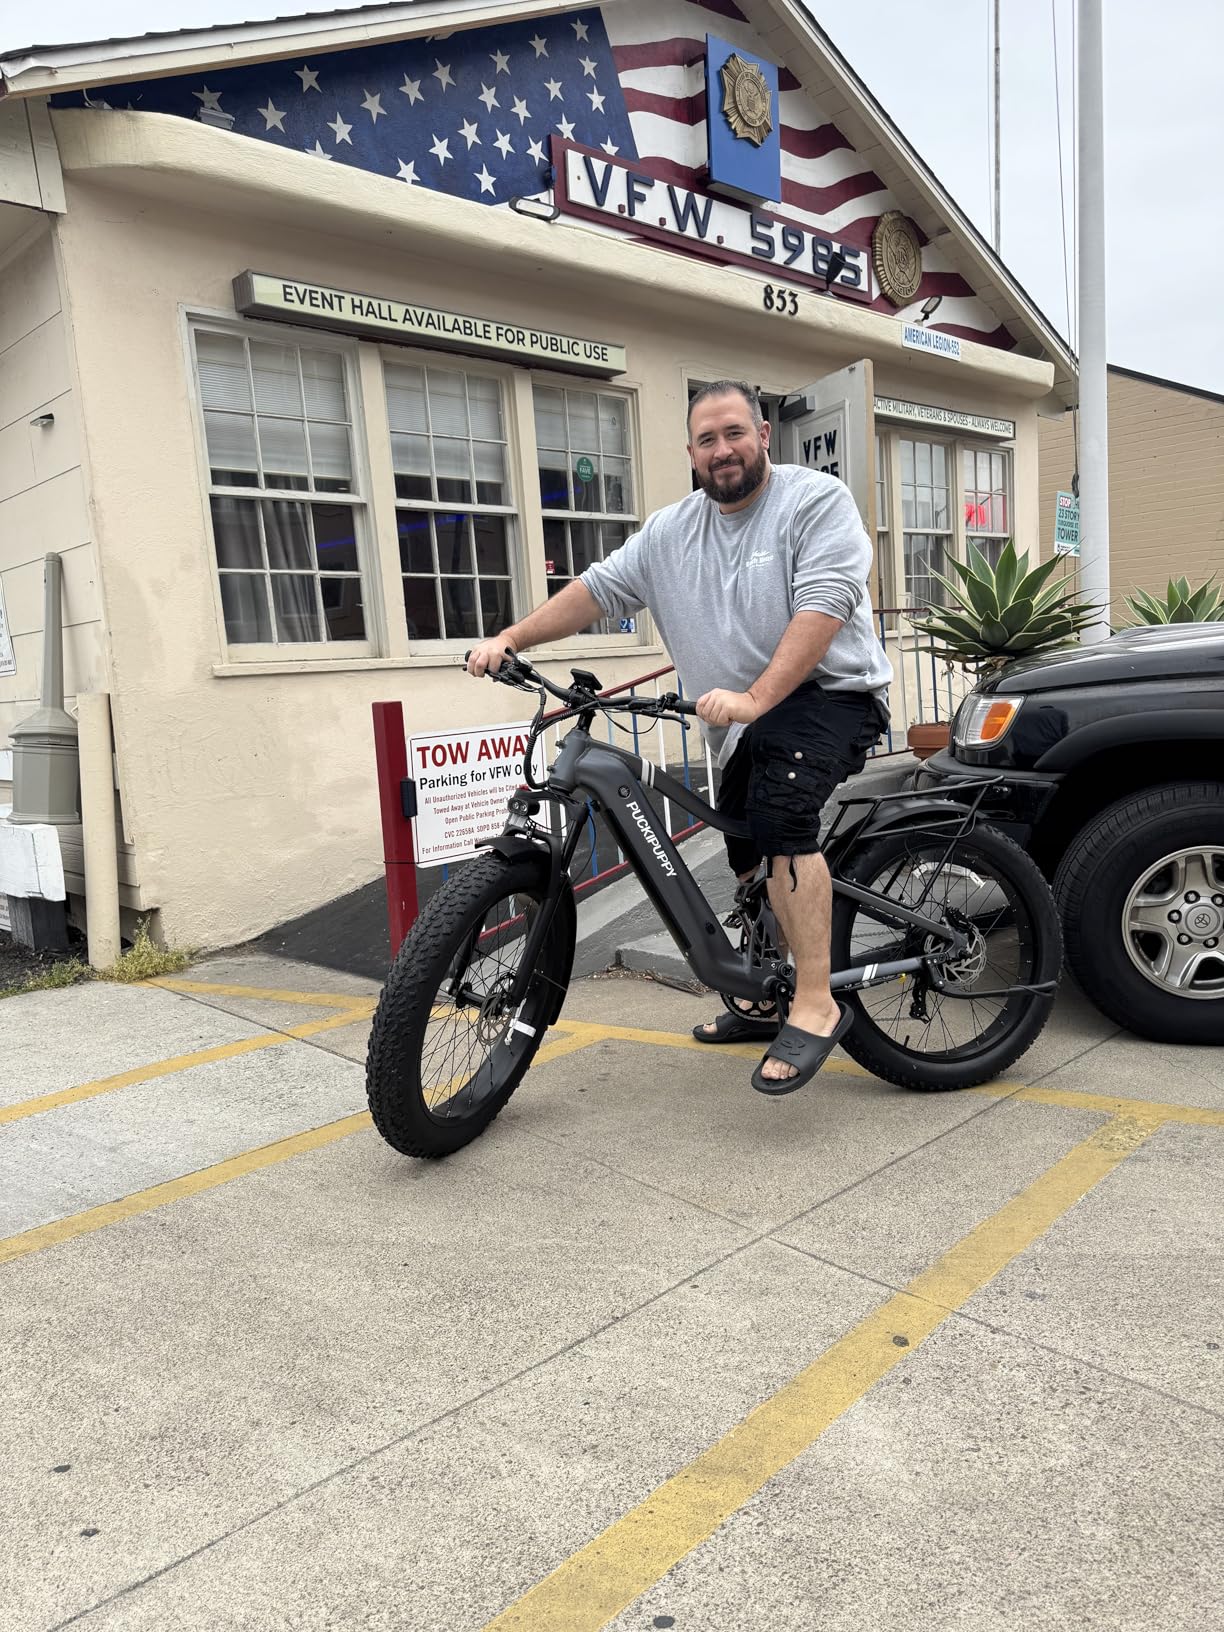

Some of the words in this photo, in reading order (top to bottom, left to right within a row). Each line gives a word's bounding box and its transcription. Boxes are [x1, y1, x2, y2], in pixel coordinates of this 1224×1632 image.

[751, 213, 861, 286] 5985
[763, 284, 799, 316] 853
[282, 284, 345, 312] EVENT
[351, 298, 398, 322] HALL
[402, 308, 492, 340] AVAILABLE
[496, 326, 526, 347] FOR
[530, 333, 580, 356] PUBLIC
[584, 344, 609, 362] USE
[904, 327, 932, 347] AMERICAN
[916, 406, 942, 421] VETERANS
[947, 412, 968, 426] SPOUSES
[971, 417, 990, 430] ALWAYS
[990, 420, 1012, 434] WELCOME
[1060, 496, 1071, 508] STOP
[1058, 508, 1065, 518] 23
[1057, 528, 1079, 542] TOWER
[417, 741, 470, 769] TOW
[420, 770, 468, 790] Parking
[470, 770, 487, 785] for
[489, 765, 511, 780] VFW
[514, 763, 538, 776] Oy
[433, 791, 467, 804] Unauthorized
[467, 788, 489, 798] Vehicles
[433, 806, 450, 815] Towed
[451, 804, 464, 813] Away
[471, 799, 489, 809] Vehicle
[445, 816, 459, 825] Open
[459, 812, 475, 822] Public
[476, 808, 495, 819] Parking
[445, 830, 455, 839] CVC
[476, 823, 490, 833] SDPD
[626, 801, 677, 877] PUCKIPUPPY
[433, 841, 463, 852] Information
[464, 838, 473, 846] Call
